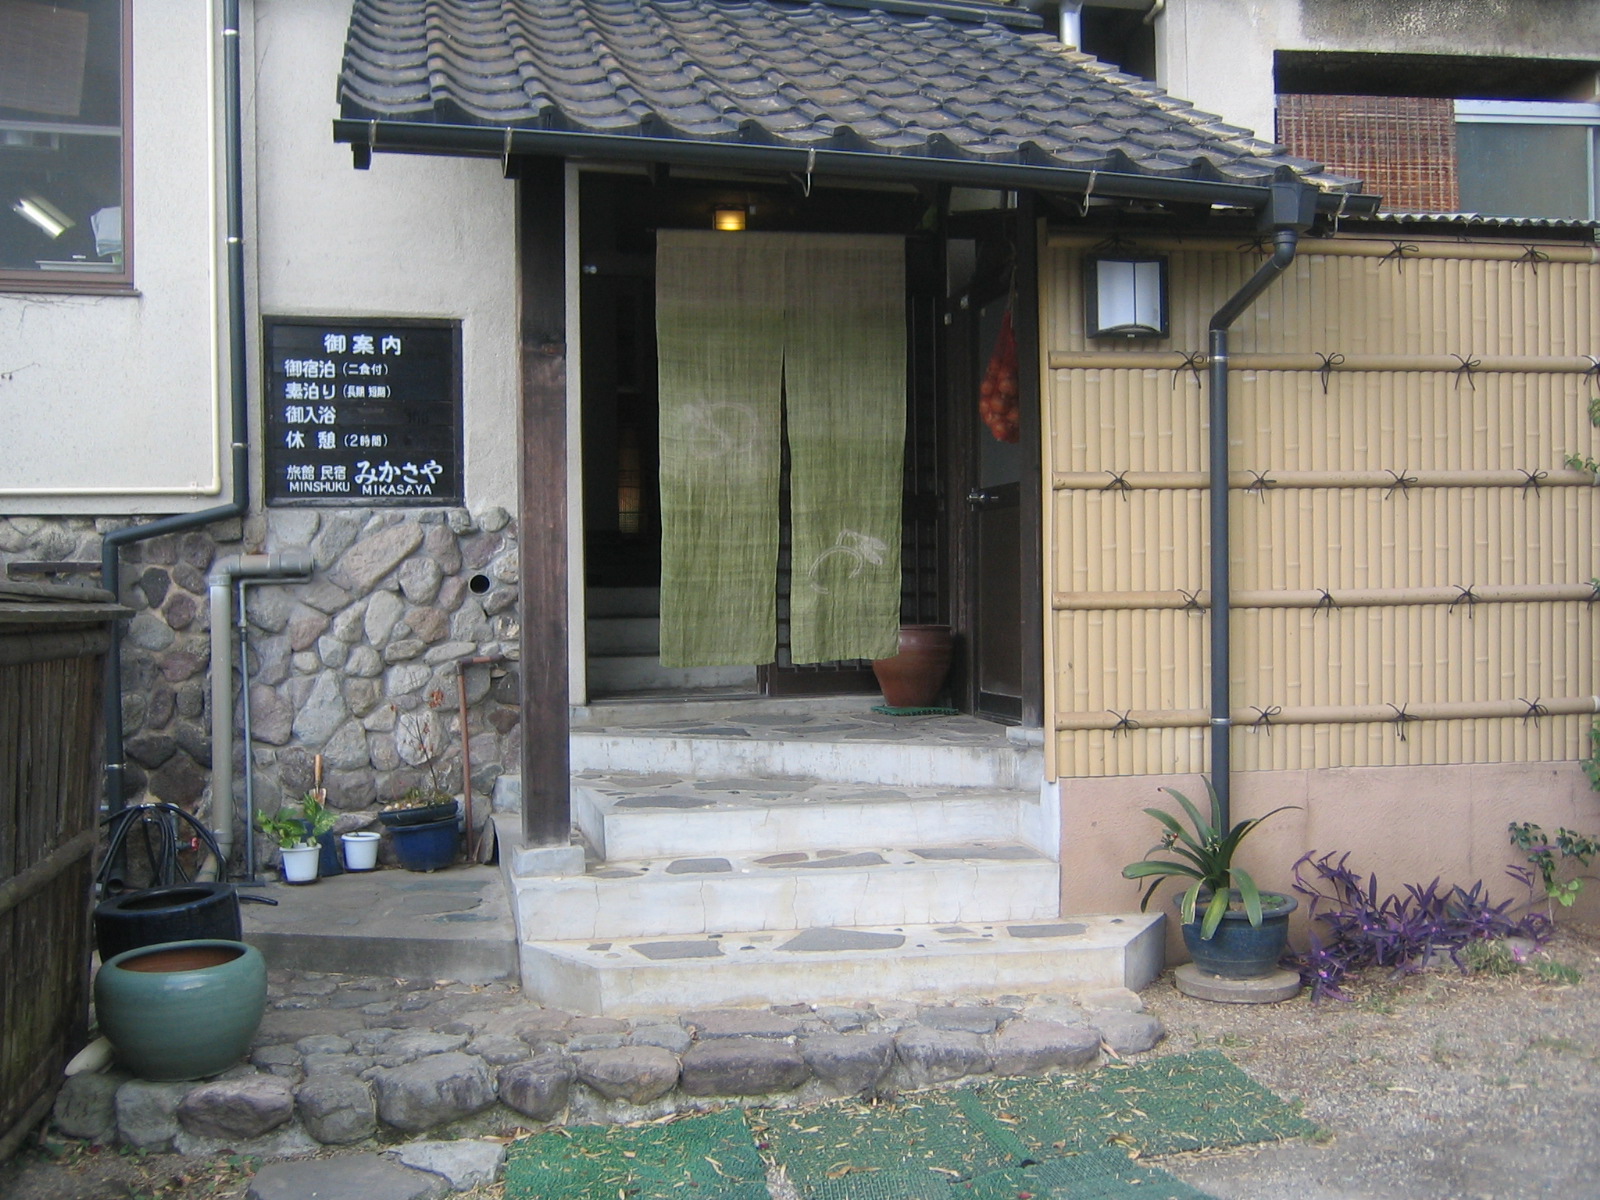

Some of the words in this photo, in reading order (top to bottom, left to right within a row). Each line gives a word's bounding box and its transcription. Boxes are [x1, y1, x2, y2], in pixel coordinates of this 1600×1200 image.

[323, 333, 402, 356] 御案内
[284, 359, 336, 379] 御宿泊
[285, 382, 336, 400] 素泊り
[285, 405, 336, 425] 御入浴
[355, 460, 443, 484] みかさや
[289, 481, 350, 493] MINSHUKU
[362, 484, 432, 496] MIKASAYA
